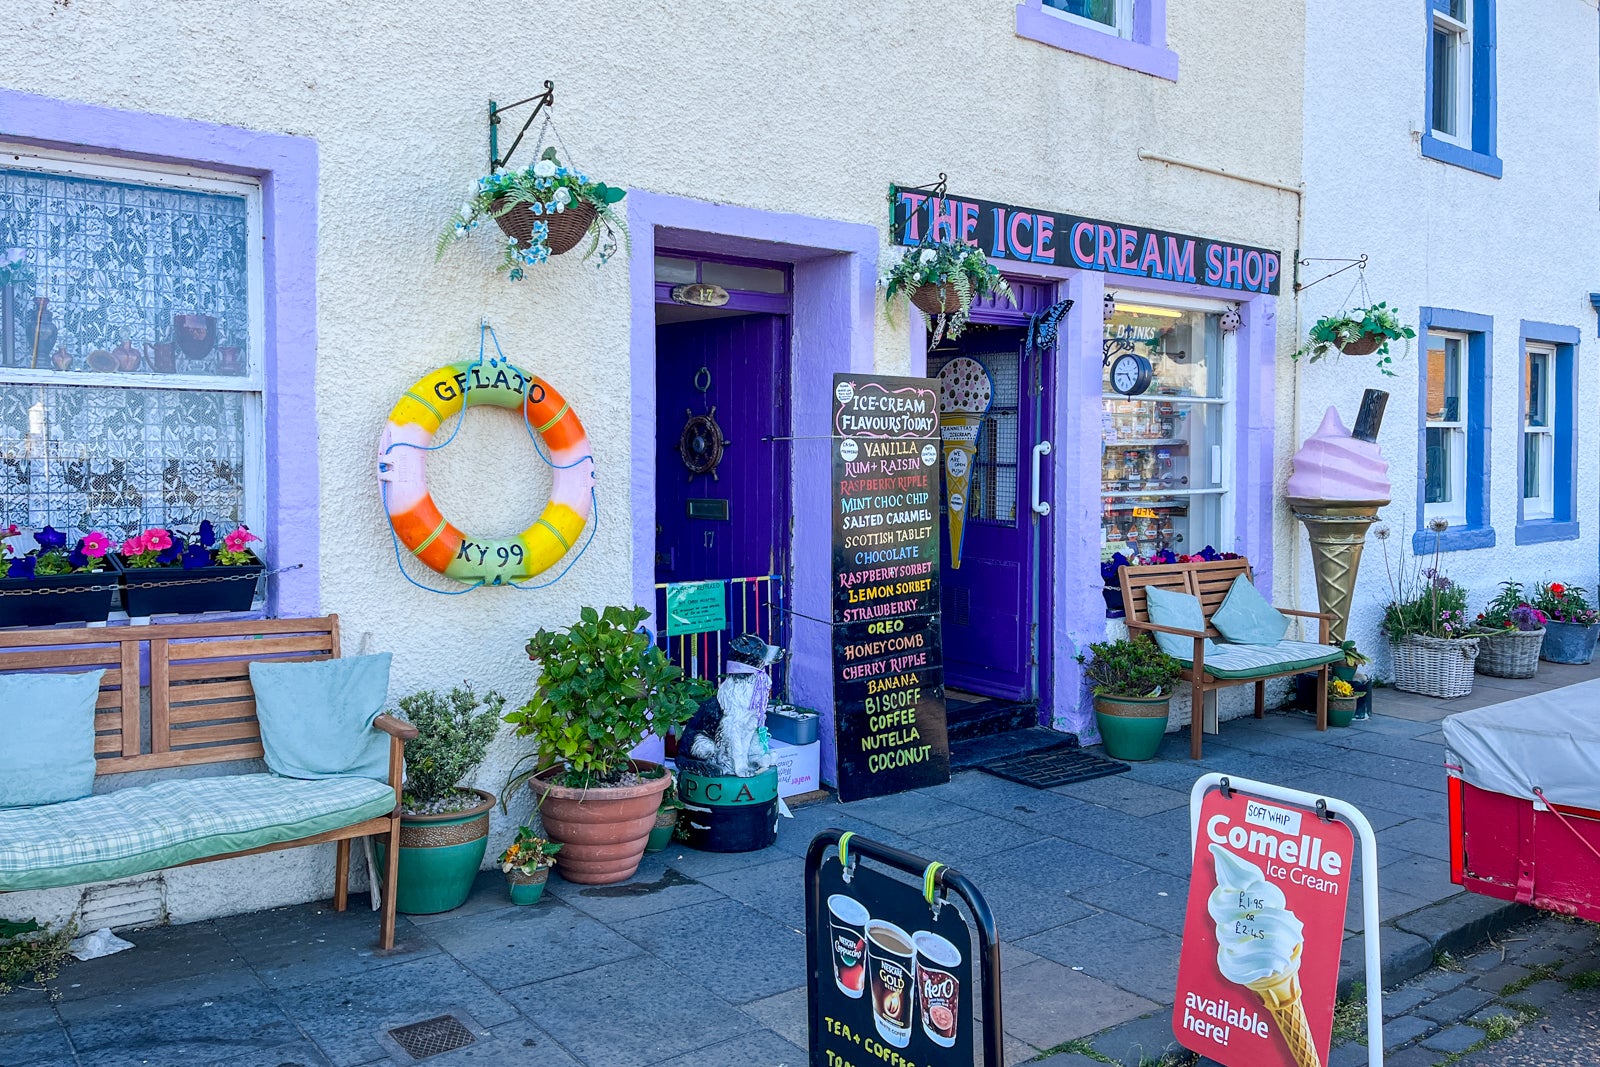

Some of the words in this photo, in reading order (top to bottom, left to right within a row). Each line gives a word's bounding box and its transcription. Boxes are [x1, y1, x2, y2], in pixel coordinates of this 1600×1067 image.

[897, 192, 979, 247] THE
[990, 207, 1055, 264] ICE
[1071, 222, 1197, 283] CREAM
[1205, 244, 1280, 294] SHOP
[700, 288, 713, 301] 17
[434, 369, 545, 404] GELATO
[853, 395, 926, 413] ICE-CREAM
[841, 414, 902, 433] FLAVOURS
[901, 412, 933, 431] TODAY
[864, 441, 919, 458] VANILLA
[881, 458, 920, 475] RAISIN
[840, 478, 896, 496] RASPBERRY
[898, 475, 928, 491] RIPPLE
[841, 496, 872, 514] MINT
[874, 494, 904, 508] CHOC
[906, 492, 929, 505] CHIP
[843, 514, 883, 530] SALTED
[886, 509, 932, 524] CARAMEL
[844, 531, 893, 549] SCOTTISH
[896, 526, 932, 542] TABLET
[456, 539, 488, 566] KY
[497, 544, 524, 567] 99
[855, 545, 919, 565] CHOCOLATE
[840, 566, 899, 589] RASPBERRY
[899, 561, 932, 577] SORBET
[848, 585, 894, 603] LEMON
[895, 578, 932, 595] SORBET
[843, 598, 918, 622] STRAWBERRY
[867, 619, 904, 634] OREO
[844, 633, 924, 661] HONEYCOMB
[842, 660, 887, 680] CHERRY
[890, 652, 927, 673] RIPPLE
[867, 672, 919, 695] BANANA
[865, 687, 921, 715] BISCOFF
[869, 707, 916, 732] COFFEE
[861, 726, 920, 752] NUTELLA
[868, 744, 932, 774] COCONUT
[791, 775, 811, 785] wafer
[1248, 804, 1267, 820] SOFT
[1267, 809, 1290, 827] WHIP
[1207, 814, 1342, 876] Comelle
[1266, 860, 1287, 880] Ice
[1290, 868, 1338, 895] Cream
[1246, 913, 1255, 922] OR
[879, 969, 905, 989] GOLD
[1183, 1008, 1230, 1046] here!
[1185, 992, 1269, 1039] available
